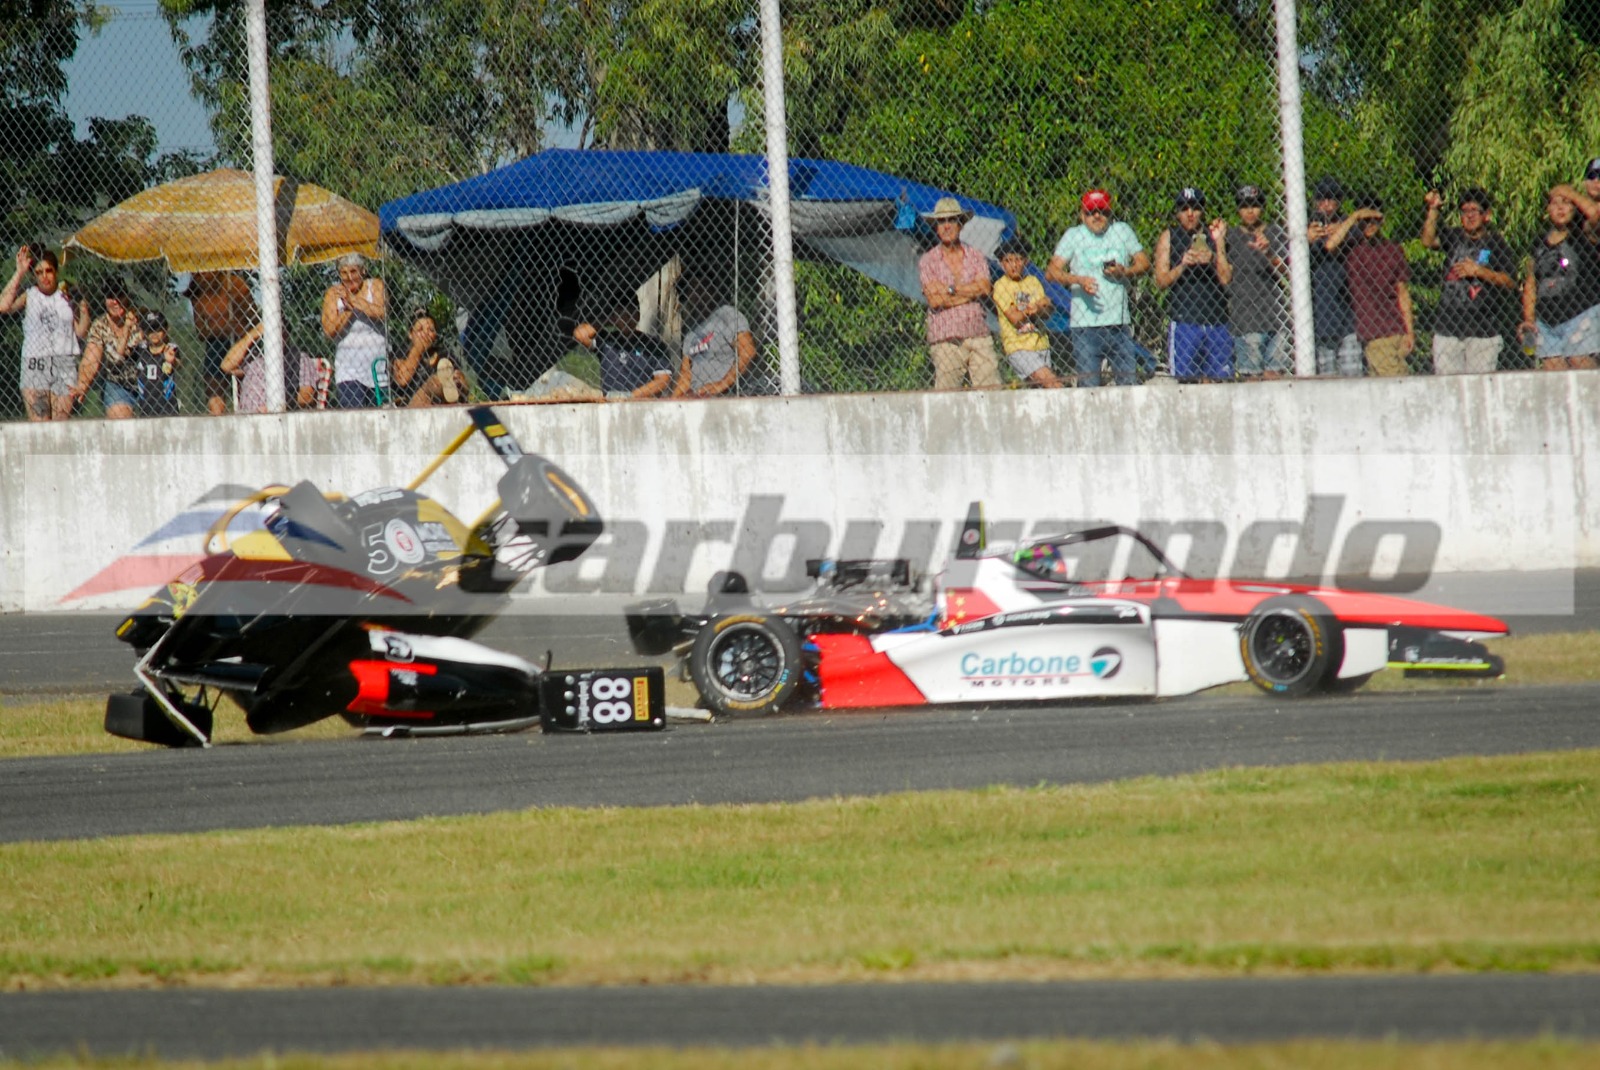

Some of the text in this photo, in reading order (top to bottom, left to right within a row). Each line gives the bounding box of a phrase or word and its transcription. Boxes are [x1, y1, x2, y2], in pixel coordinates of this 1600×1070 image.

[28, 357, 45, 371] 86
[960, 652, 1081, 676] Carbone
[970, 676, 1071, 687] MOTORS
[591, 677, 632, 724] 88
